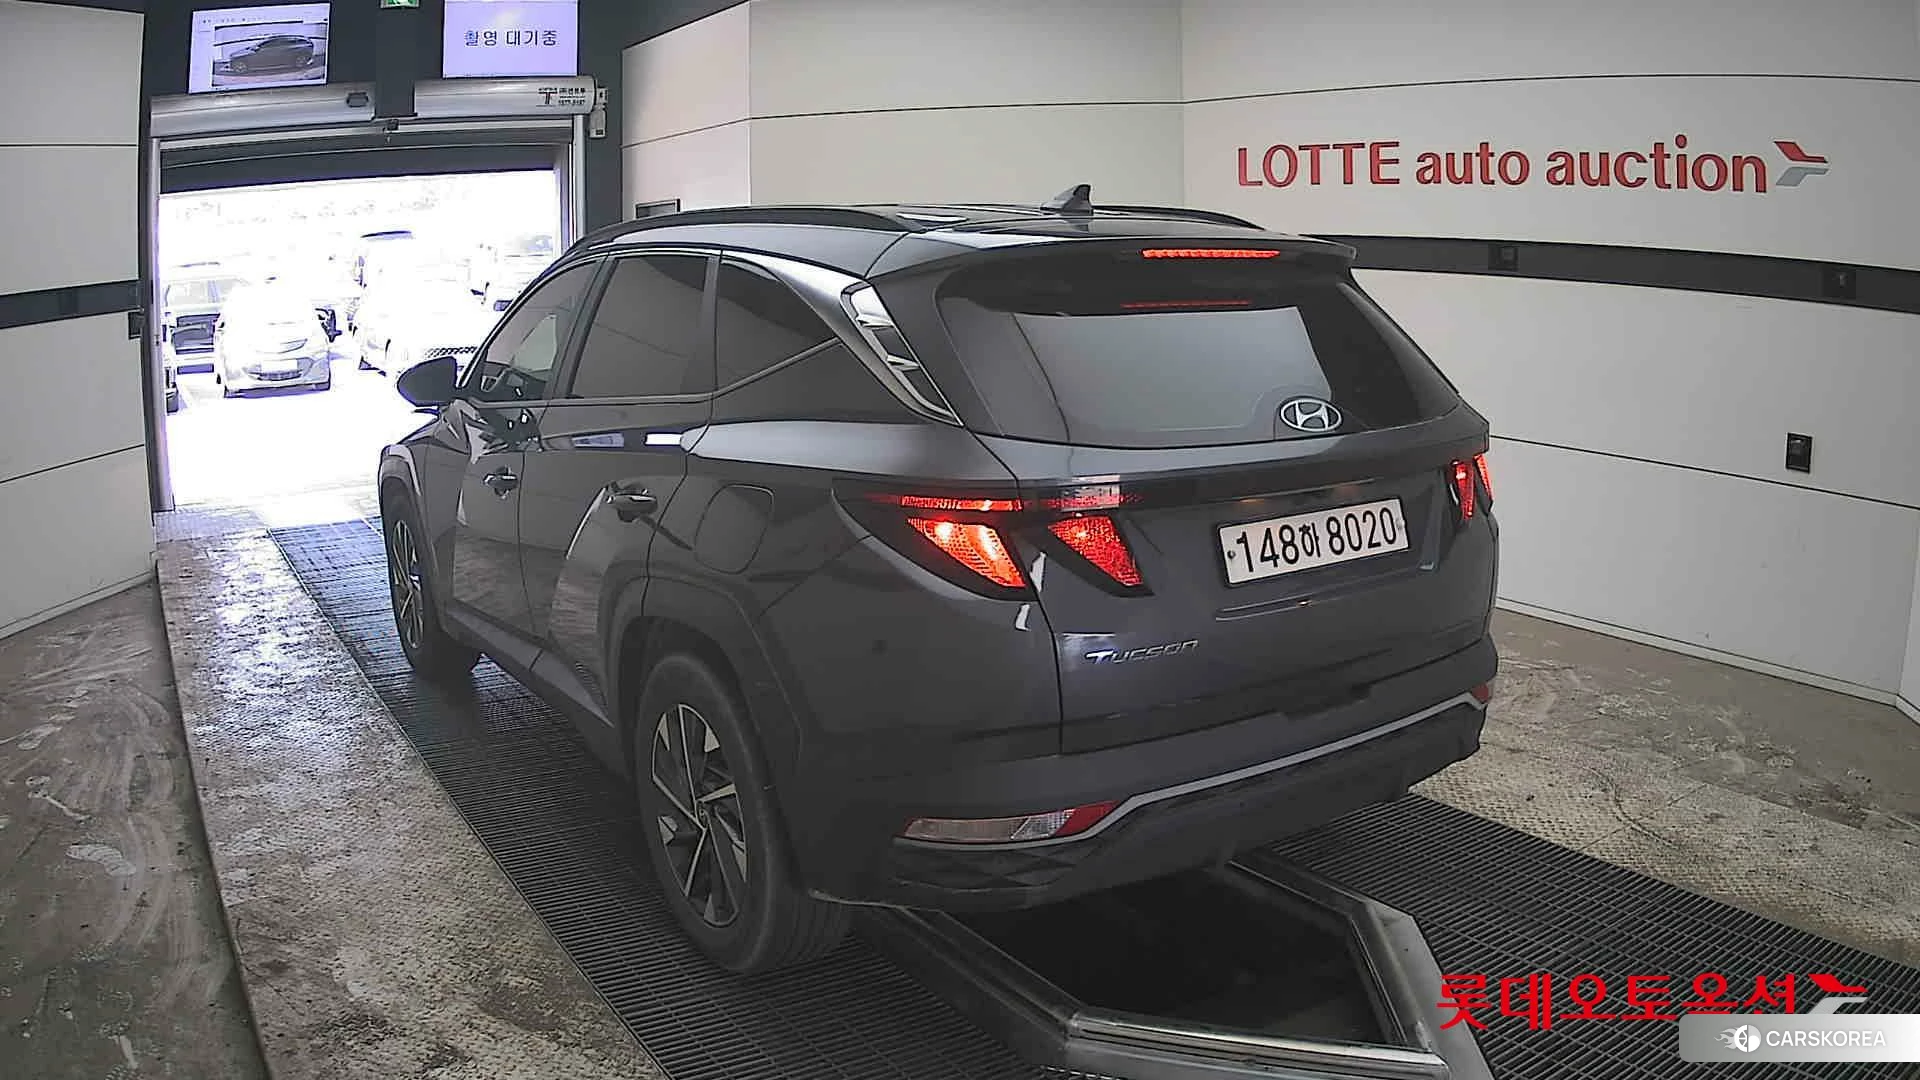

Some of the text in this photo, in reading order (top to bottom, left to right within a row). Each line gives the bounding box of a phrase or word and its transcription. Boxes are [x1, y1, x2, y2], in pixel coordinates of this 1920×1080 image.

[506, 30, 558, 46] 대기중
[1237, 134, 1769, 194] LOTTE auto auction
[1236, 507, 1397, 573] 148하 8020
